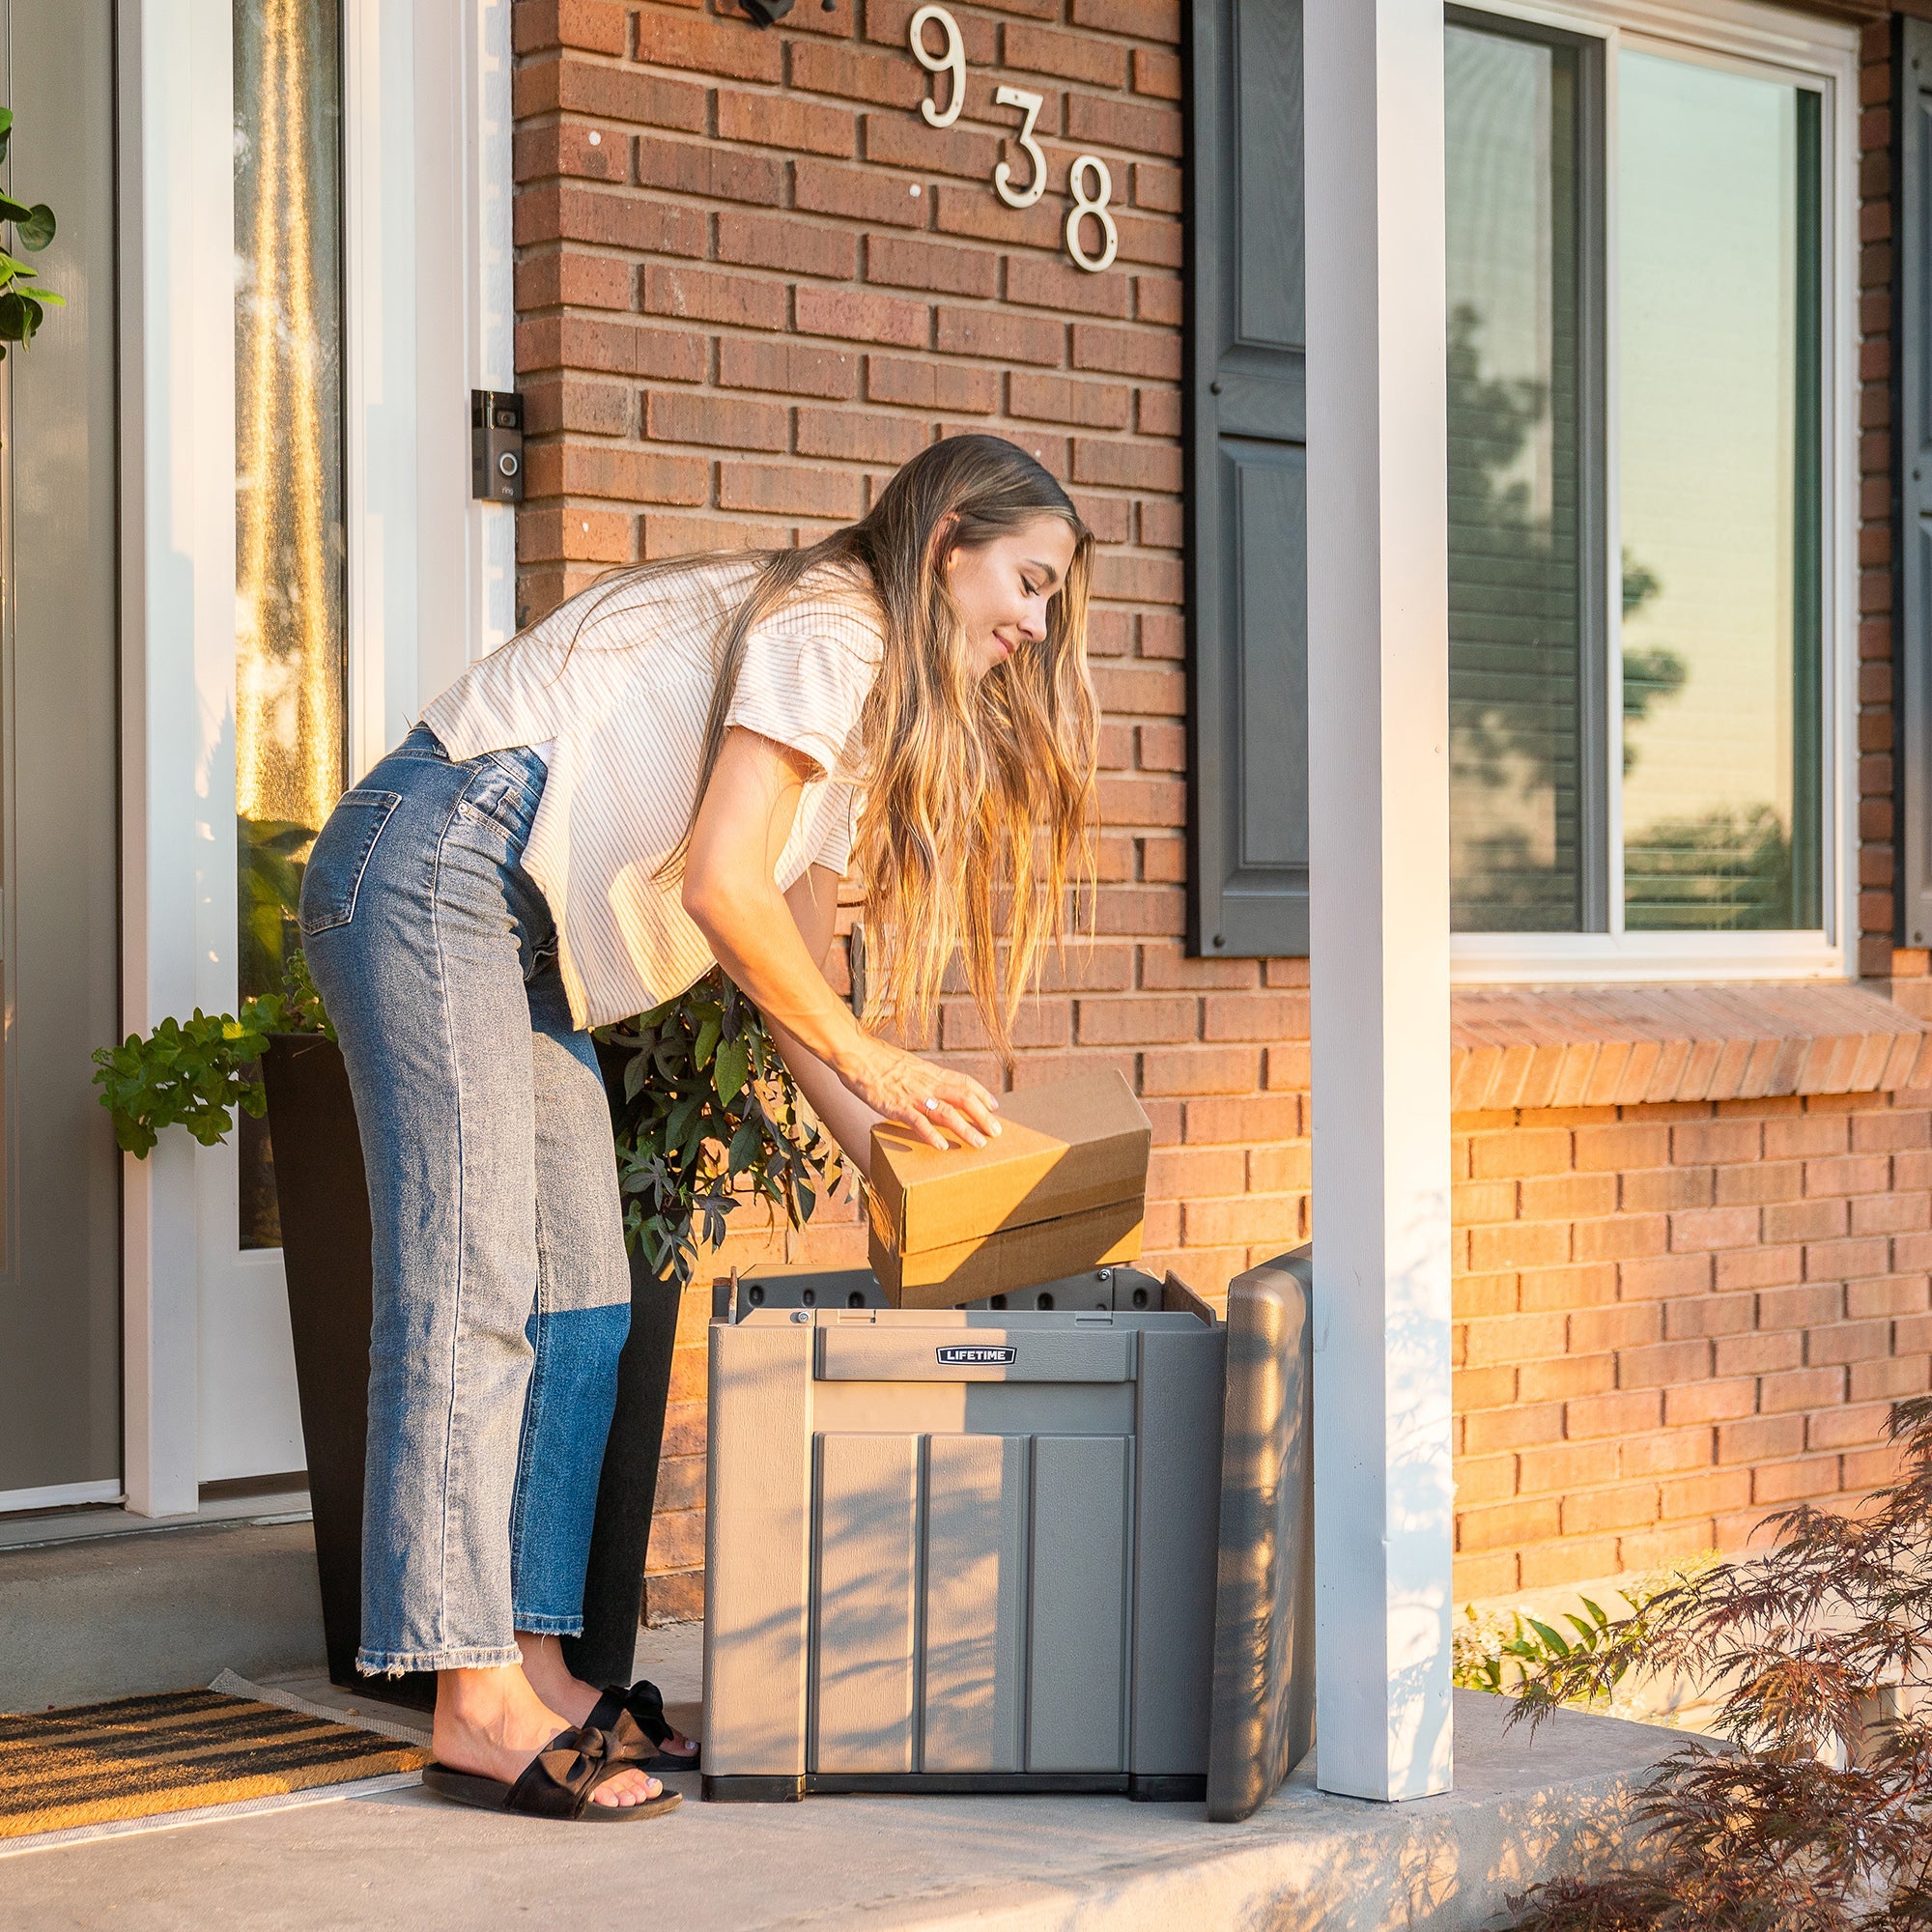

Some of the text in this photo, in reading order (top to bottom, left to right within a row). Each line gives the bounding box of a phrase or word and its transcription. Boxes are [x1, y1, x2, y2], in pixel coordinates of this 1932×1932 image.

[910, 5, 1119, 272] 938
[501, 486, 514, 497] ring
[947, 1350, 1006, 1360] LIFETIME
